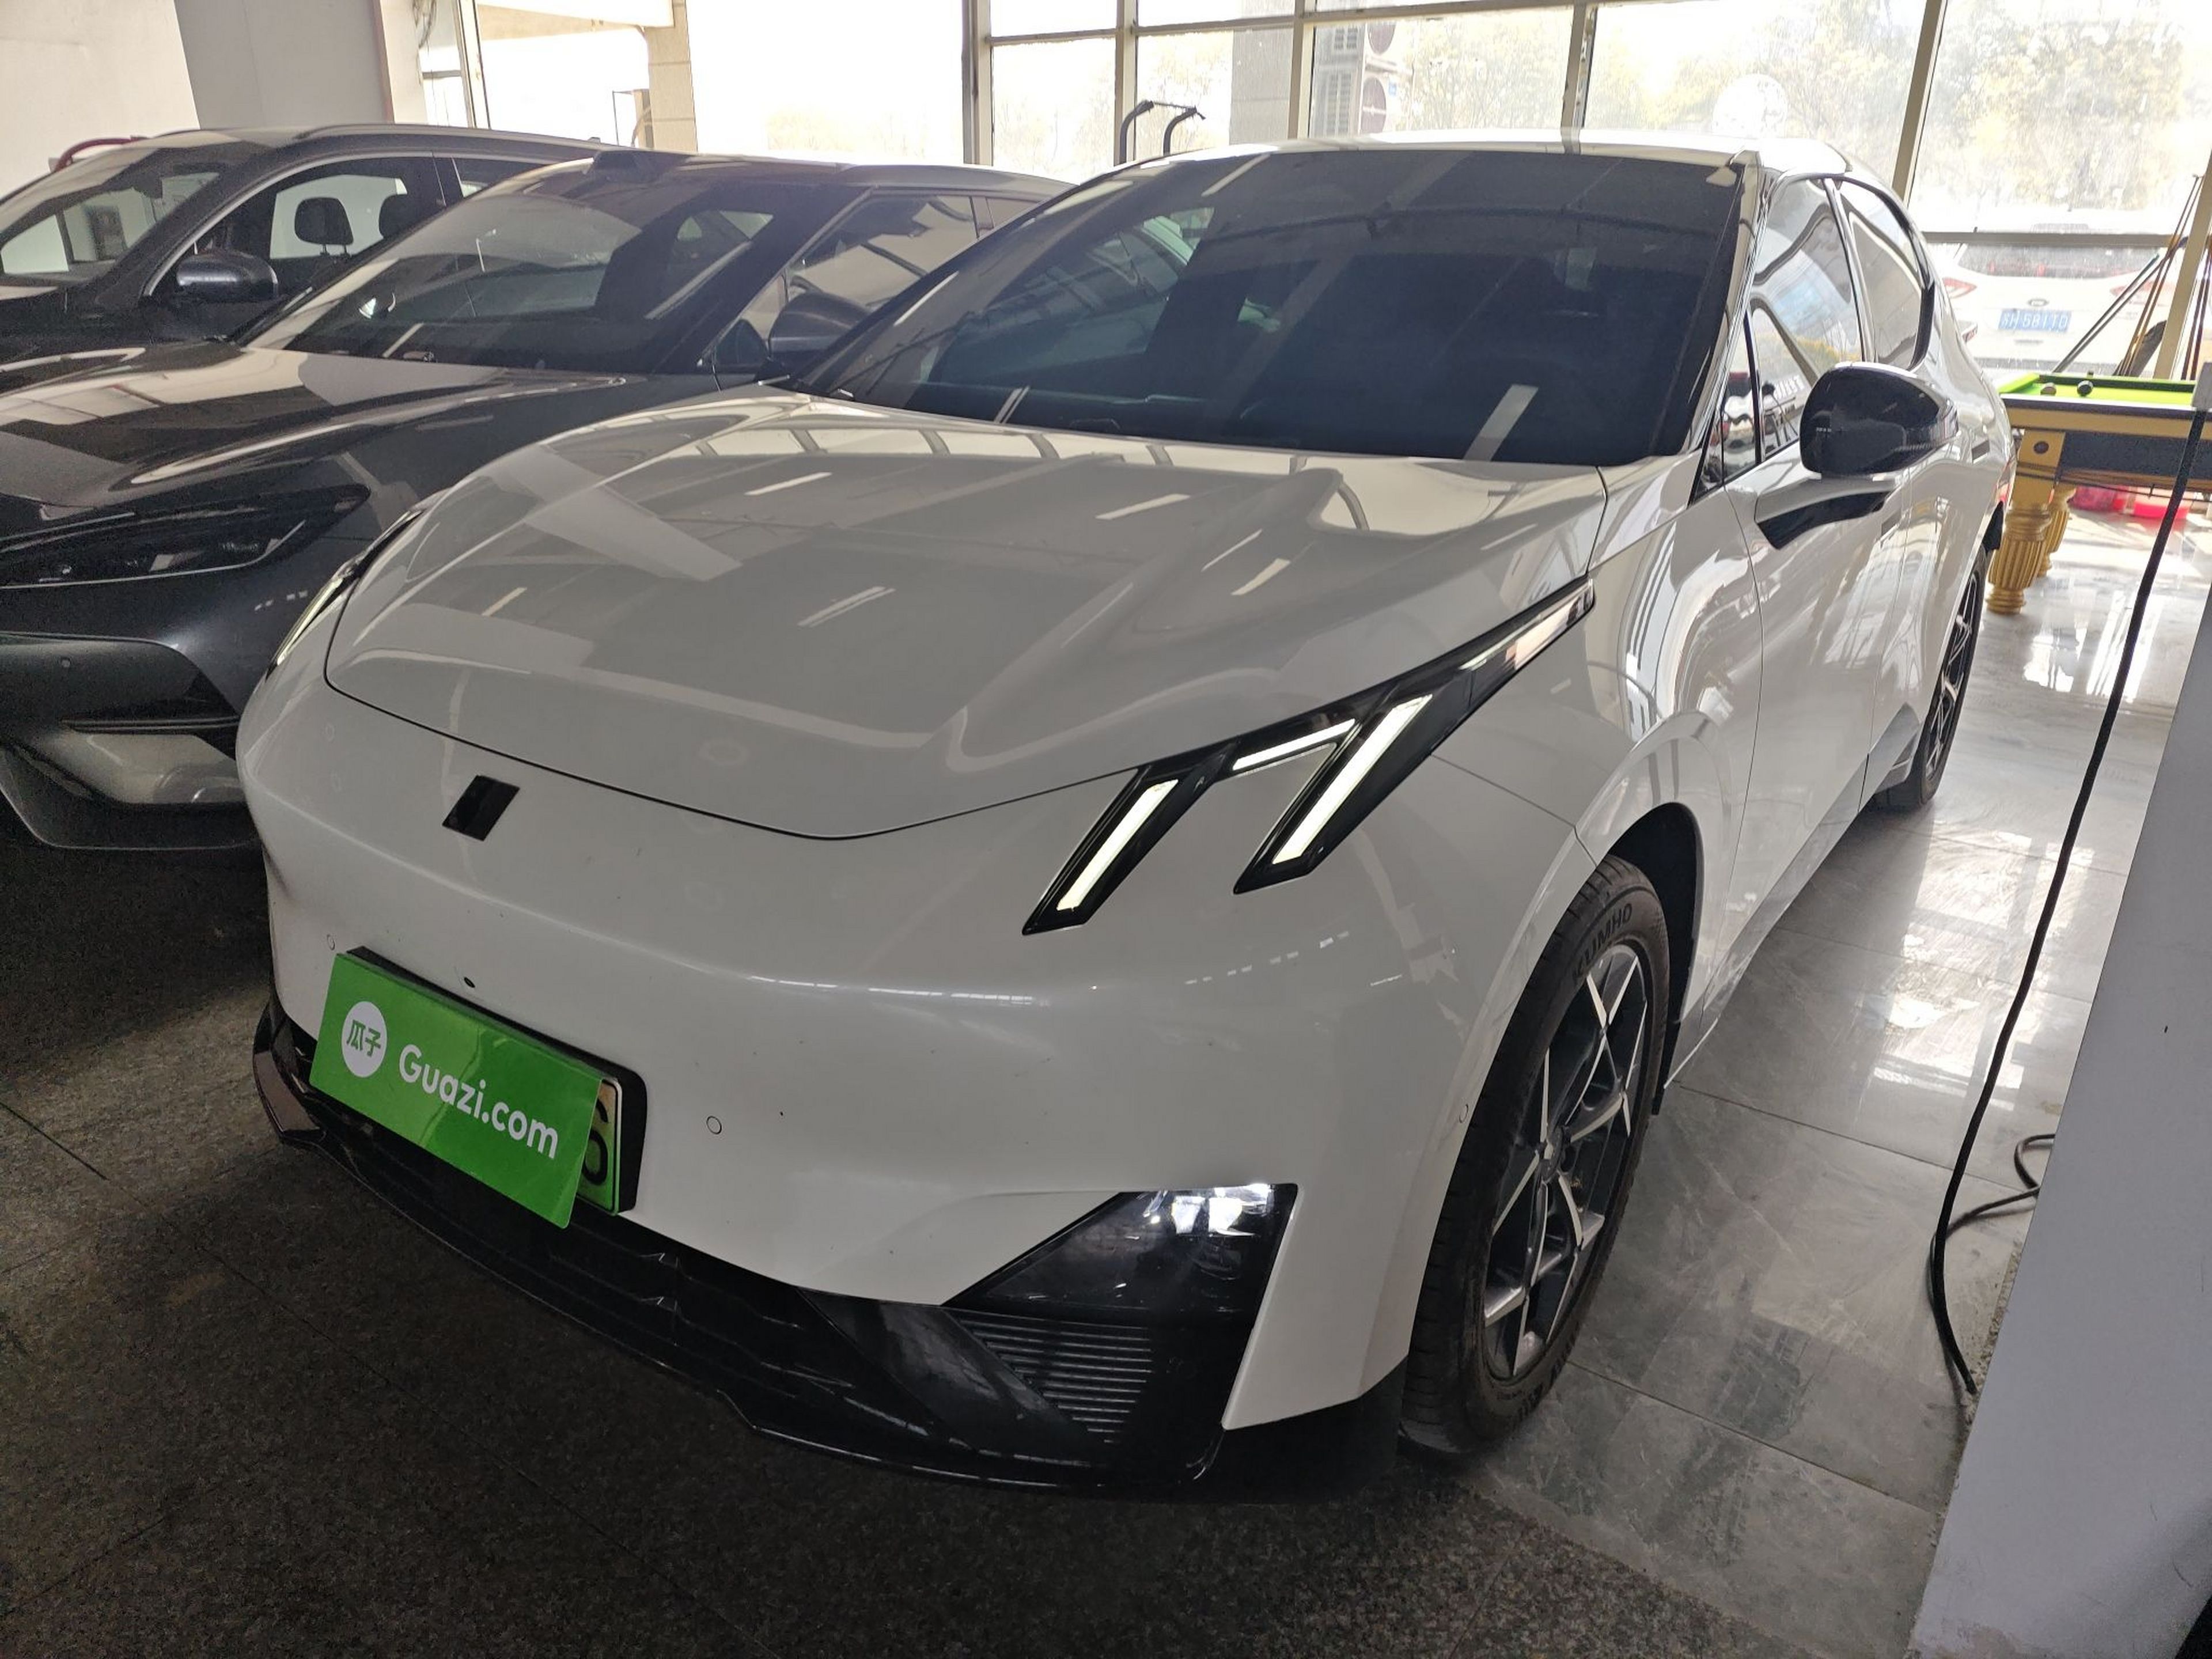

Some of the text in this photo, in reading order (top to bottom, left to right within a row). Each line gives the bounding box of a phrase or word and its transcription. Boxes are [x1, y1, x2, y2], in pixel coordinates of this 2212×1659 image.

[1571, 903, 1633, 980] KUMHO
[346, 1019, 381, 1058] 瓜子
[399, 1043, 558, 1160] Guazi.com
